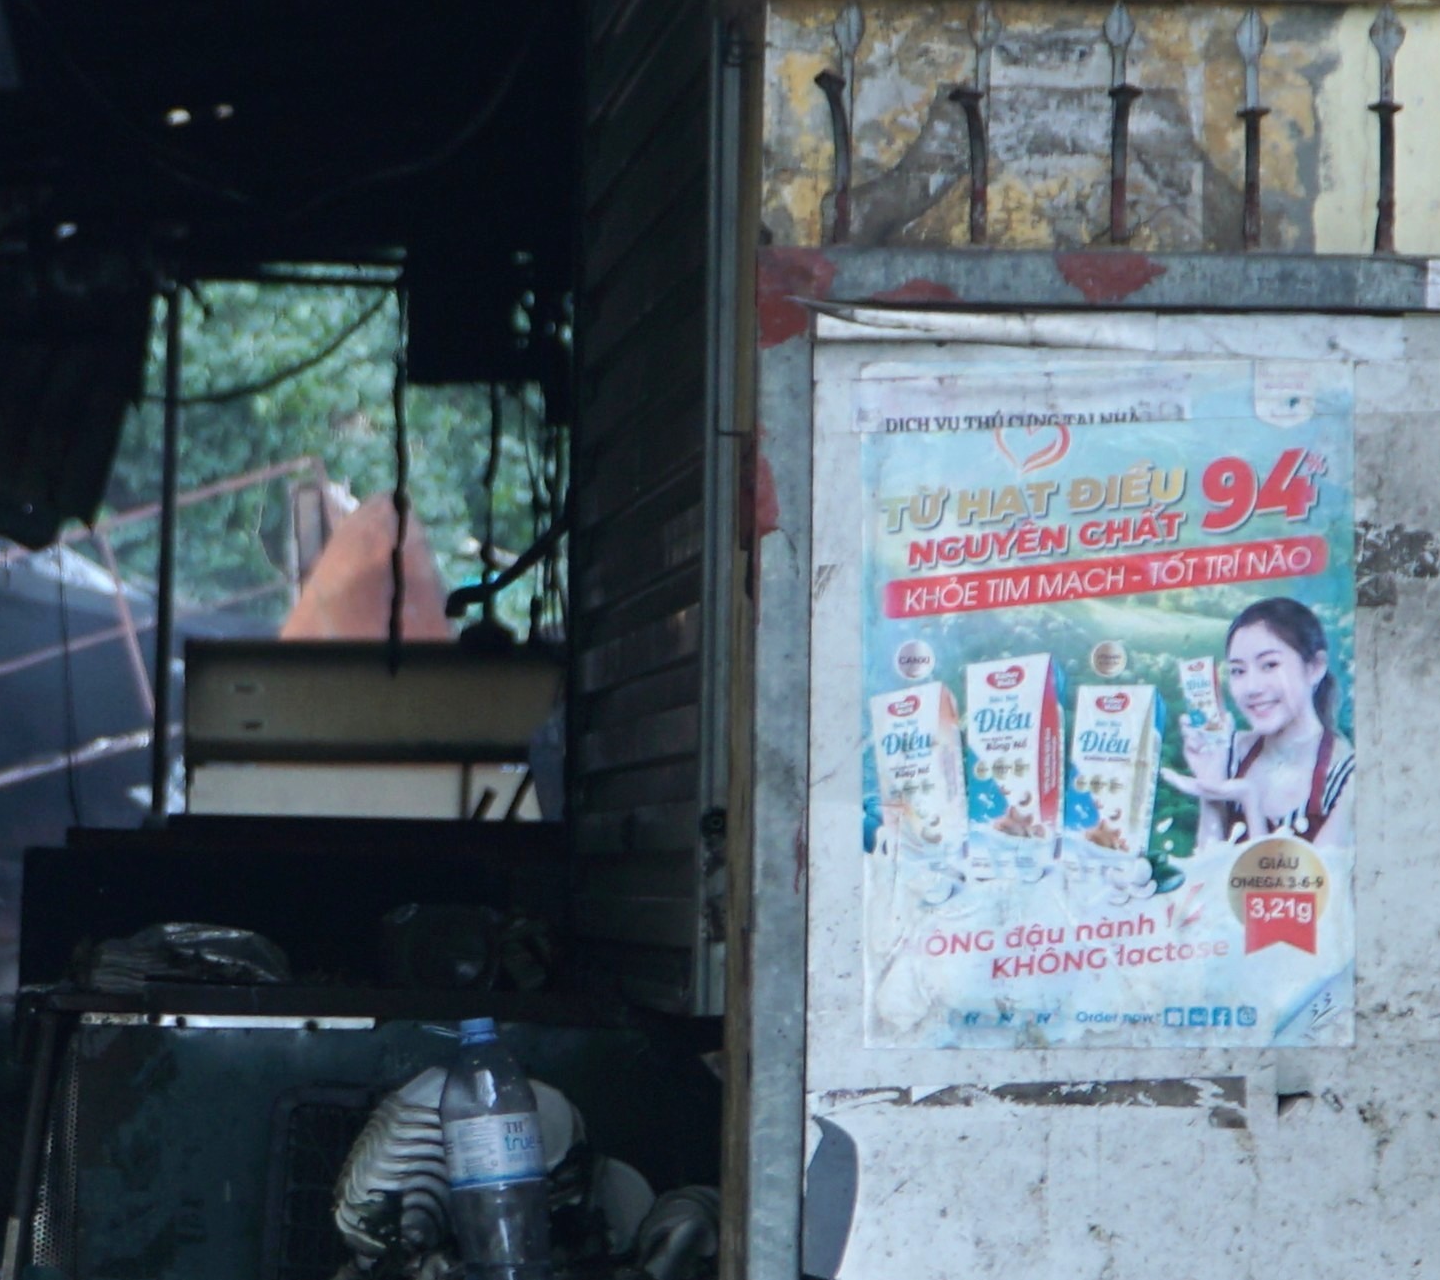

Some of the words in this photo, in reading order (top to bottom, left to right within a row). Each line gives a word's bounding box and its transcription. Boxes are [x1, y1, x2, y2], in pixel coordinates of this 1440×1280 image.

[957, 477, 1059, 528] HẠT
[907, 519, 1070, 571] NGUYÊN
[1078, 503, 1188, 551] CHẤT
[903, 573, 978, 614] KHỎE
[986, 570, 1030, 604] TIM
[1036, 565, 1126, 600] MẠCH
[1149, 552, 1197, 588] TỐT
[1245, 543, 1313, 577] NÃO
[1005, 922, 1067, 951] đậu
[1075, 914, 1156, 942] nành
[1249, 897, 1313, 924] 3,21g
[990, 946, 1108, 981] KHÔNG
[1117, 939, 1230, 968] lactose
